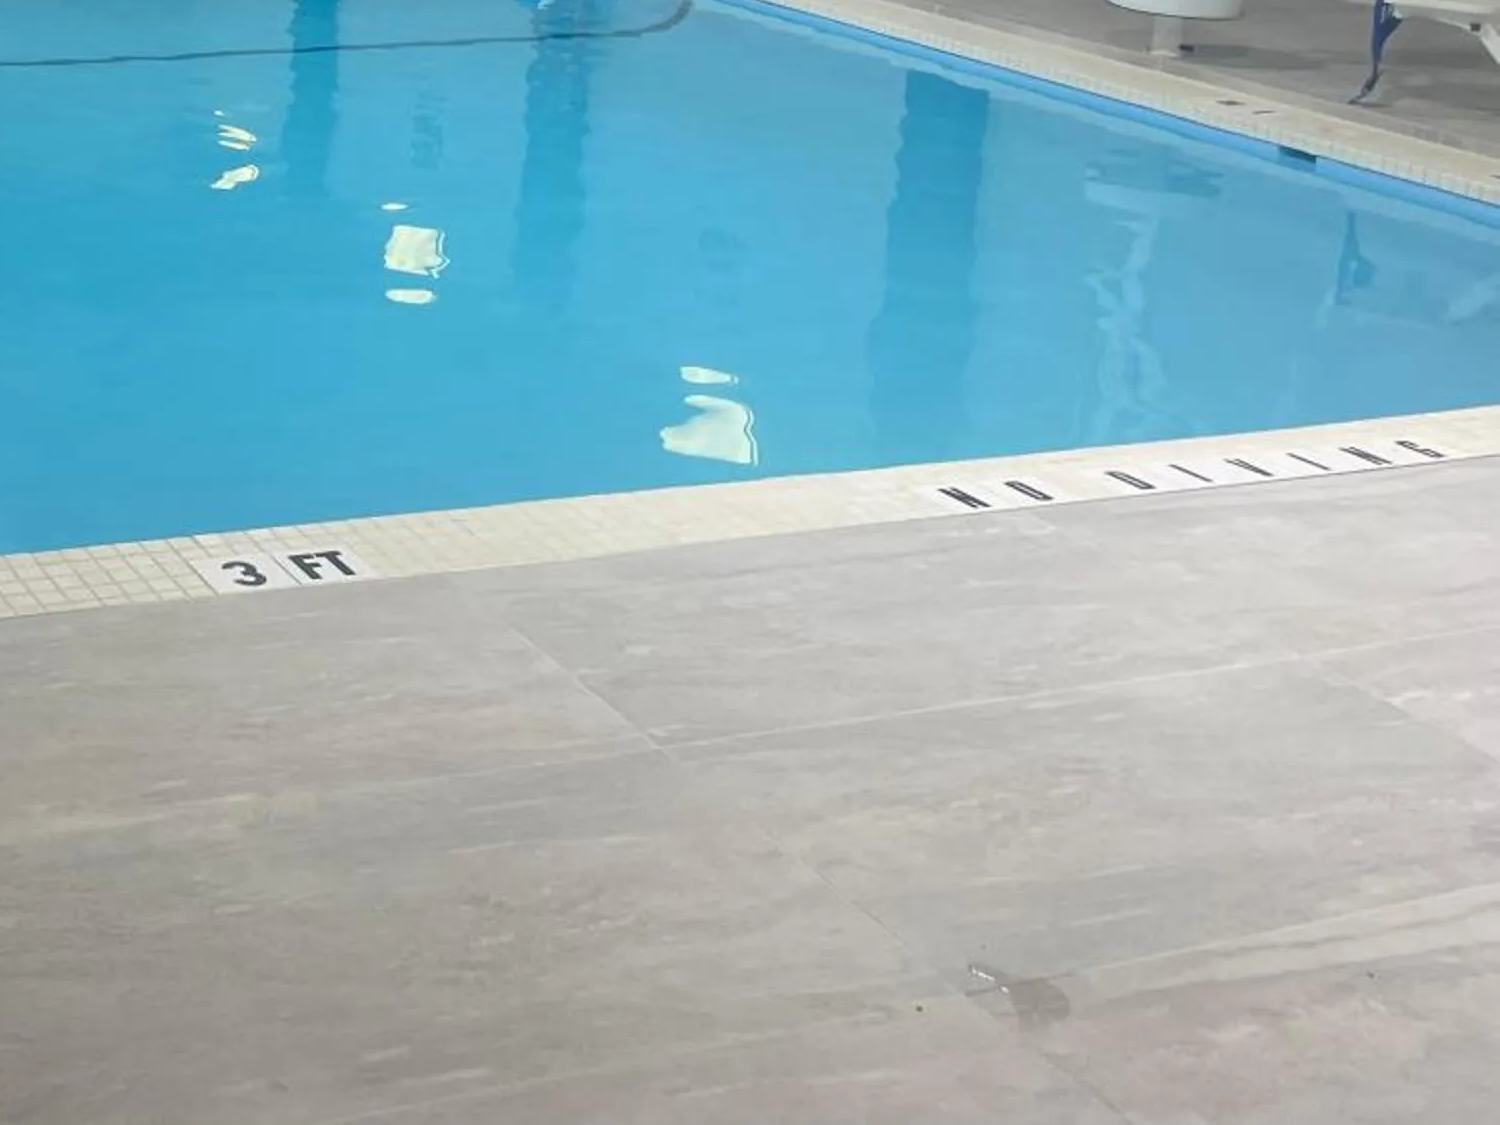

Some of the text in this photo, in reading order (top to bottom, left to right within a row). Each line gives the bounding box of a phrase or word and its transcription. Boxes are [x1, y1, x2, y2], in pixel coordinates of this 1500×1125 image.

[936, 440, 1445, 508] NO DIVING
[221, 550, 356, 586] 3 FT
